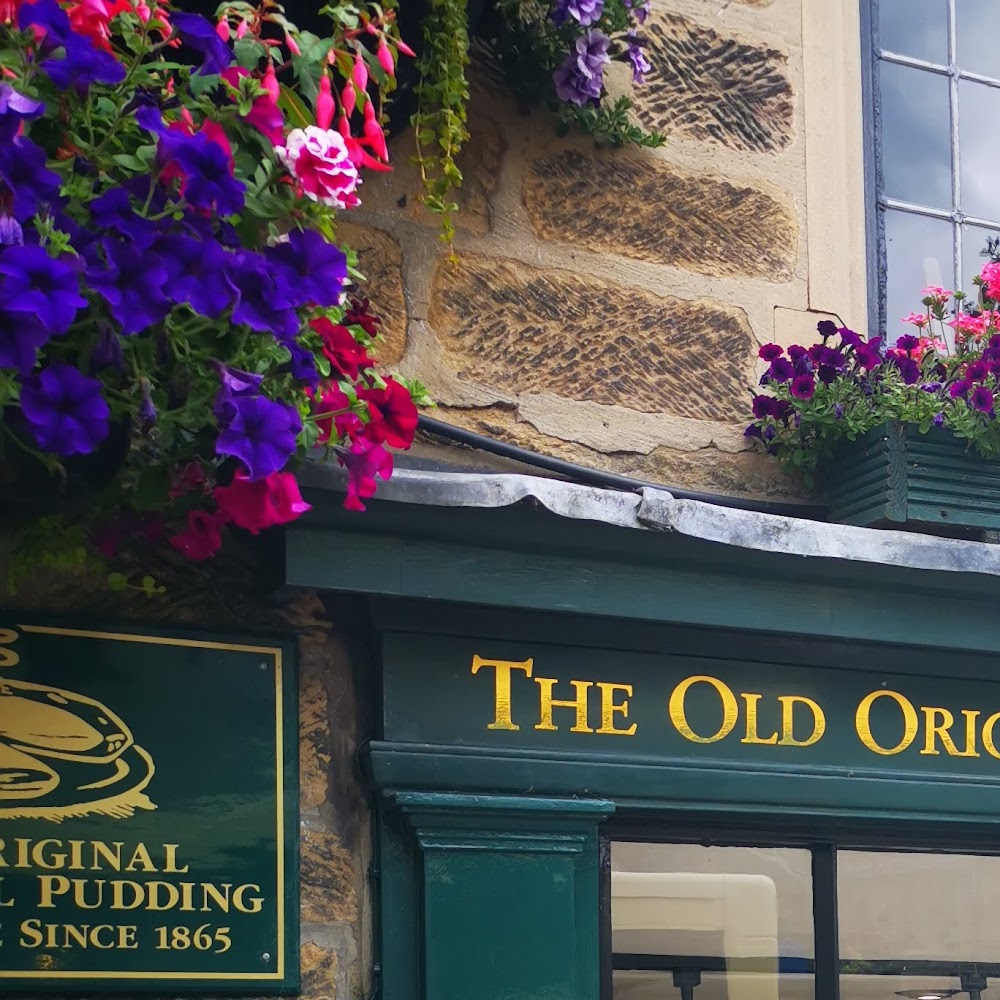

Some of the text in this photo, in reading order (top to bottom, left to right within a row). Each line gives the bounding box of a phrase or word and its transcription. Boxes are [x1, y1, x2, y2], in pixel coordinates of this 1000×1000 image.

[471, 654, 638, 736] THE
[668, 675, 826, 747] OLD
[36, 875, 265, 913] PUDDING
[19, 918, 232, 953] SINCE 1865
